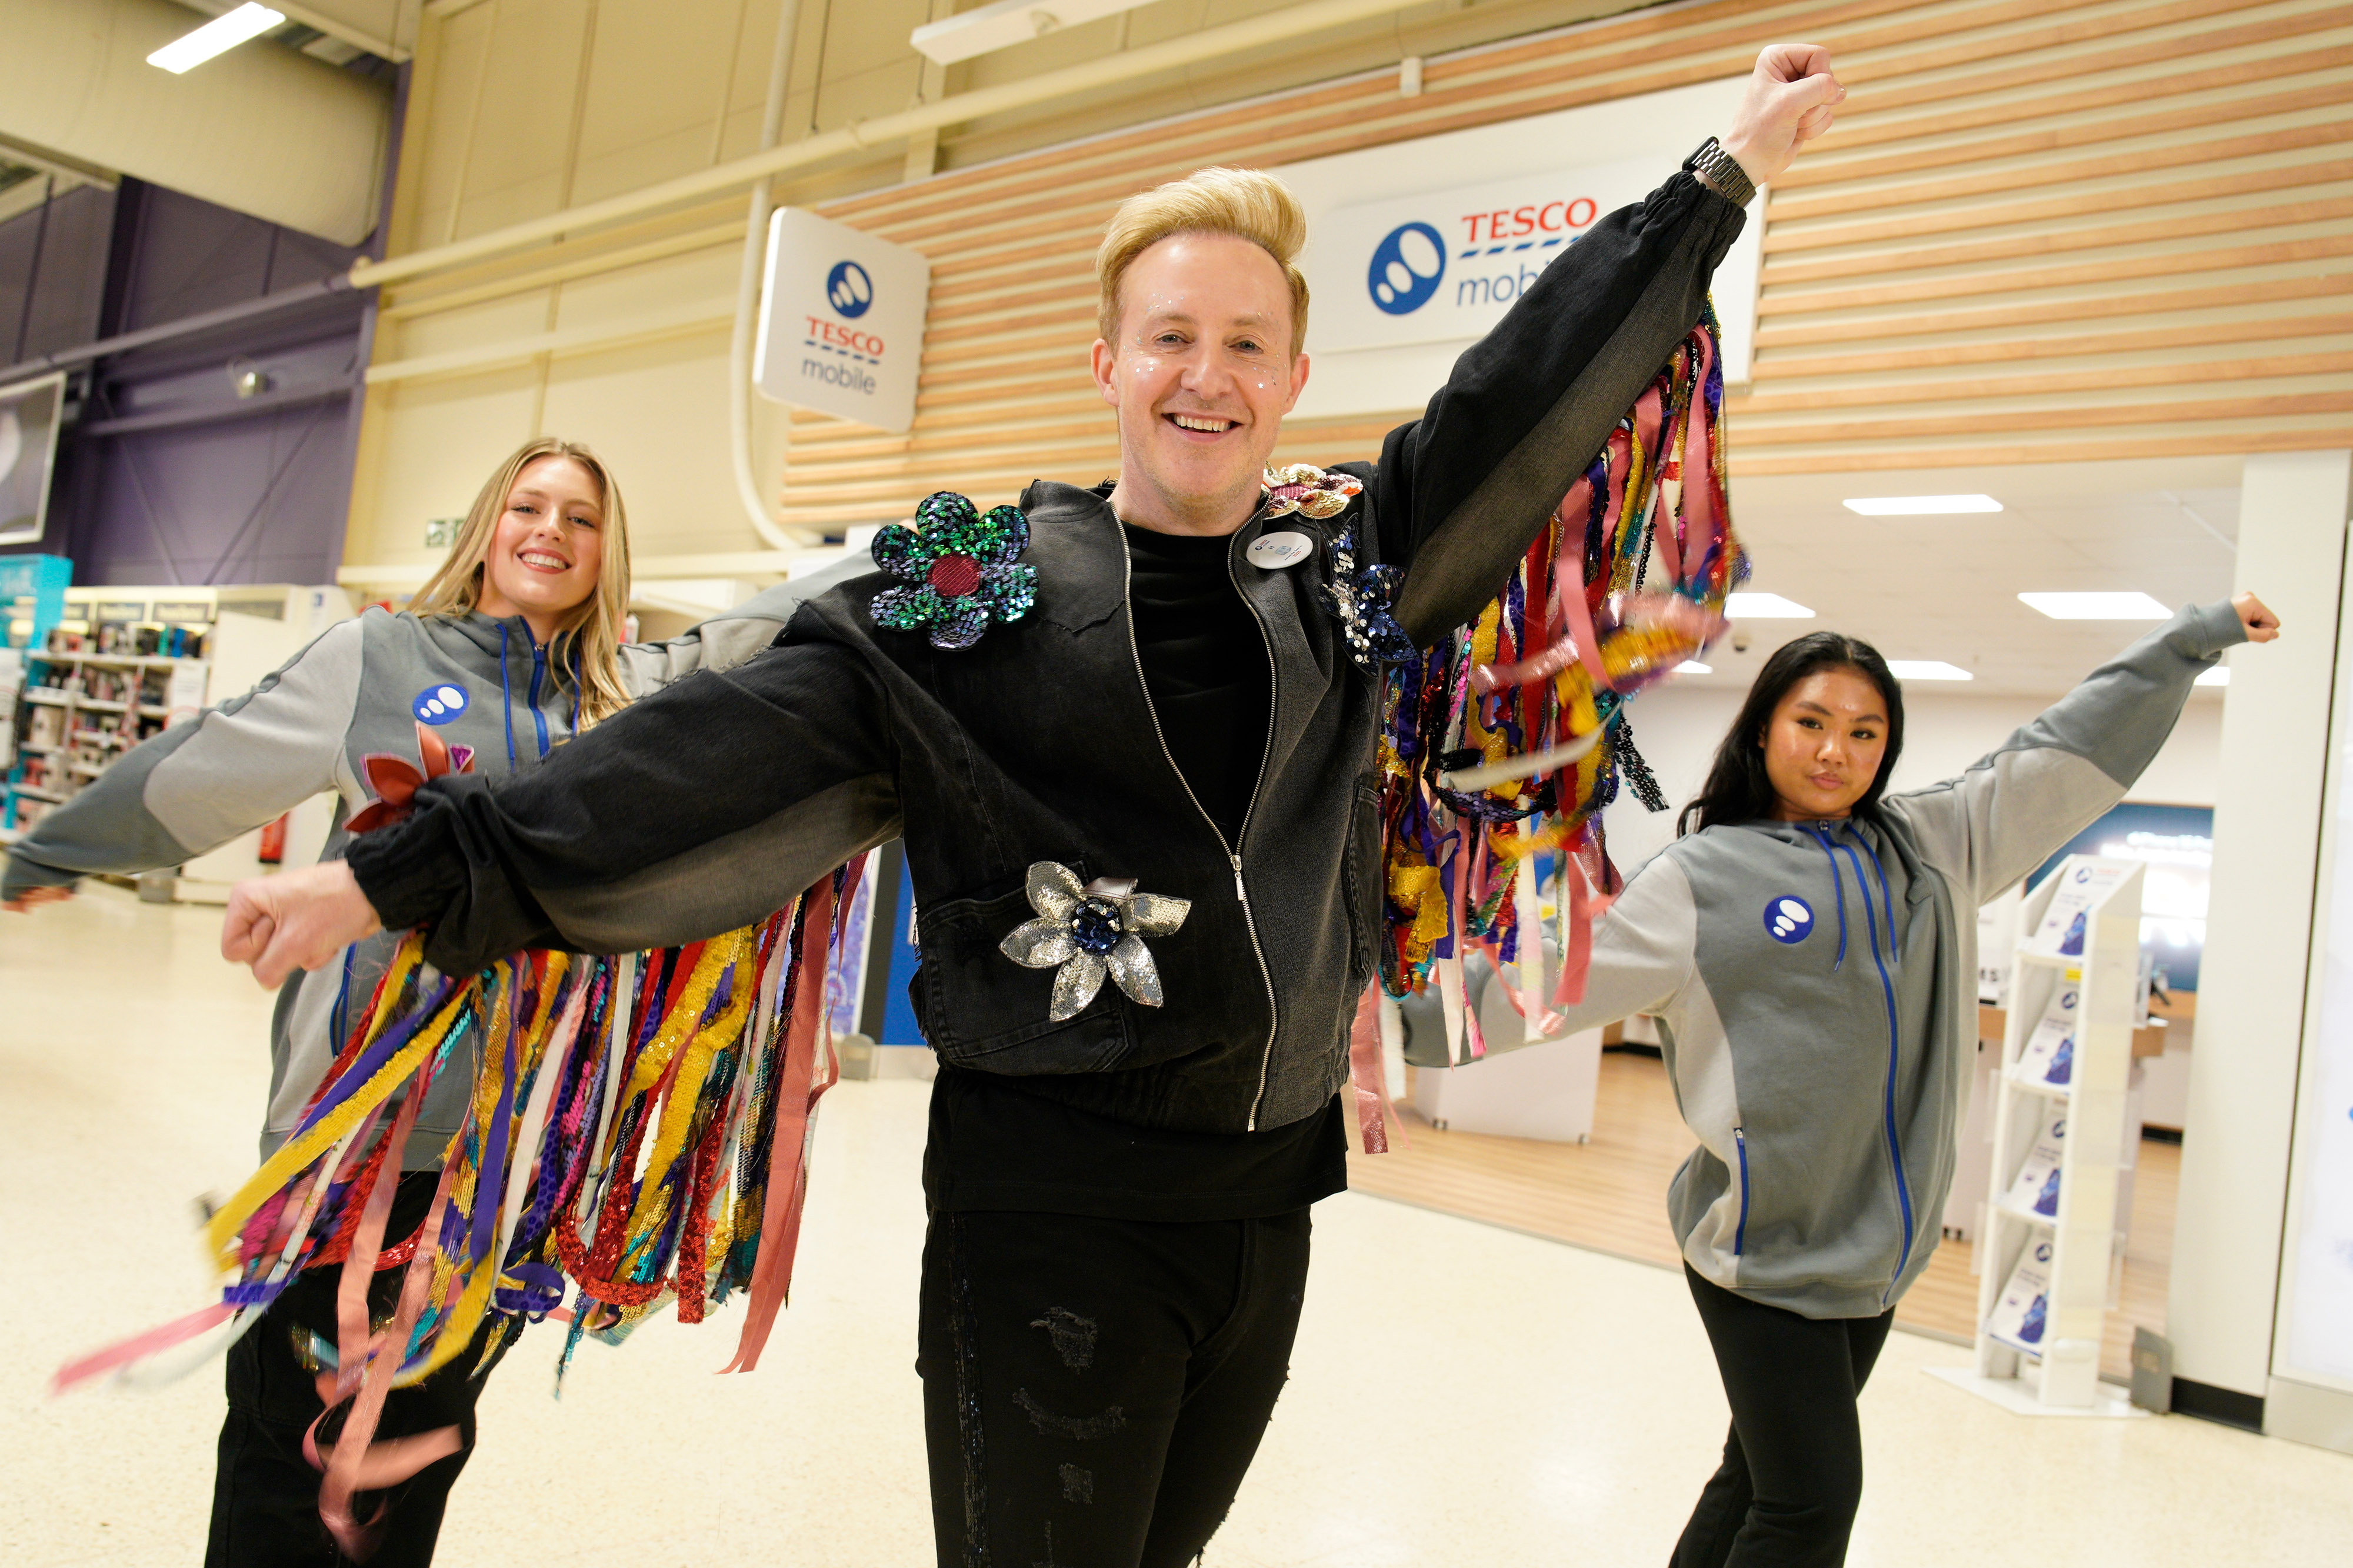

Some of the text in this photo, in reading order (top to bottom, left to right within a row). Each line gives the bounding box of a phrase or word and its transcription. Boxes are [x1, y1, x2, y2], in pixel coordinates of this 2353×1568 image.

[1461, 198, 1597, 243] TESCO
[1457, 259, 1551, 306] mob
[805, 316, 885, 356] TESCO
[801, 358, 876, 395] mobile
